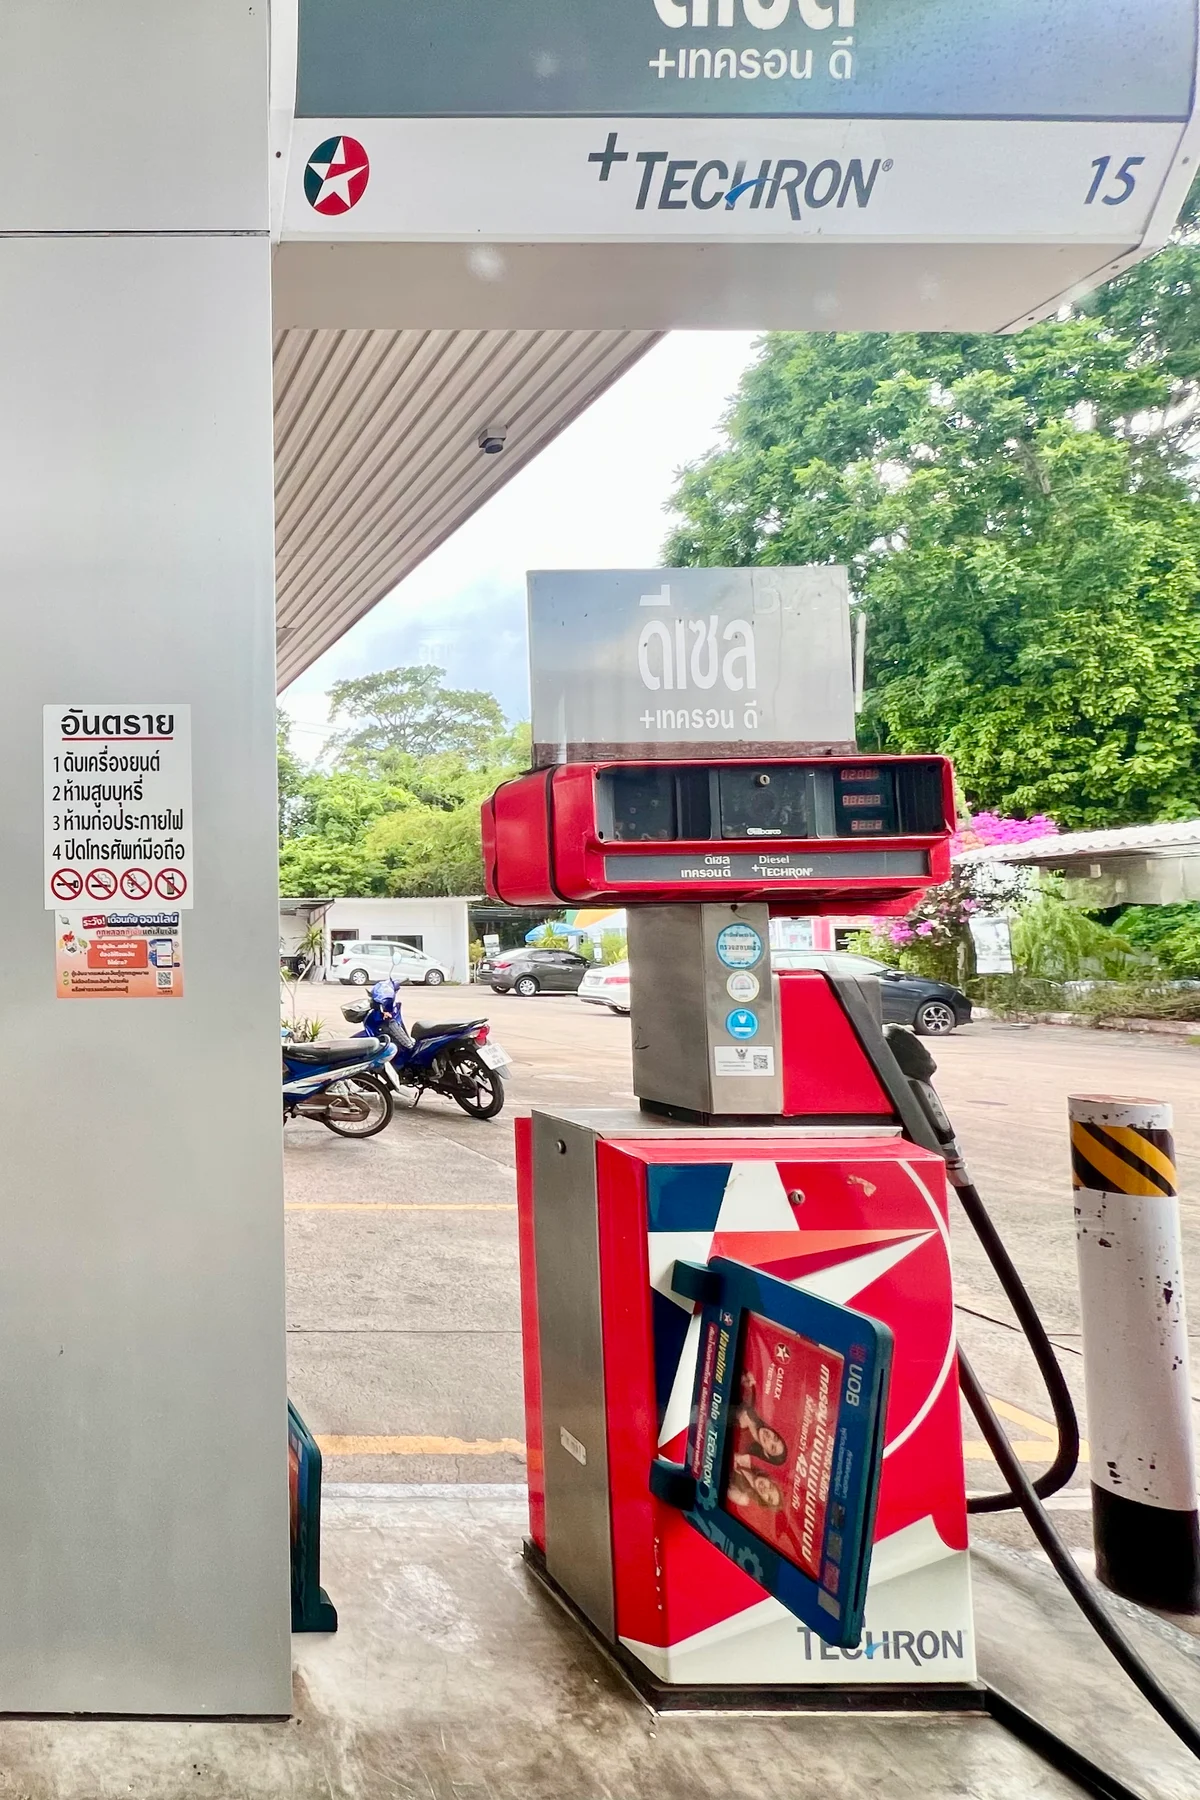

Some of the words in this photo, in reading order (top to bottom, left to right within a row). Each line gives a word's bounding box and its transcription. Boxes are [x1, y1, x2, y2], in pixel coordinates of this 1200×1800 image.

[649, 48, 813, 80] +เทครอน
[829, 36, 853, 79] ดี
[1084, 155, 1145, 207] 15
[638, 584, 756, 692] ดีเซล
[60, 708, 175, 736] อันตราย
[639, 708, 735, 730] +เทครอน
[743, 700, 759, 730] ดี
[53, 756, 59, 773] 1
[63, 745, 161, 773] ดับเครื่องยนต์
[52, 785, 61, 801] 2
[63, 774, 144, 808] ห้ามสูบบุหรี่
[52, 815, 61, 831] 3
[63, 808, 184, 831] ห้ามก่อประกายไฟ
[52, 844, 62, 861] 4
[64, 837, 186, 861] ปิดโทรศัพท์มือถือ
[704, 853, 731, 865] ดีเซล
[758, 855, 791, 864] Diesel
[714, 1328, 730, 1385] Havoline
[774, 1366, 785, 1401] CALTEX
[845, 1363, 864, 1408] UOB
[711, 1391, 723, 1421] Delo
[702, 1429, 719, 1489] TECHRON
[796, 1453, 809, 1478] 42
